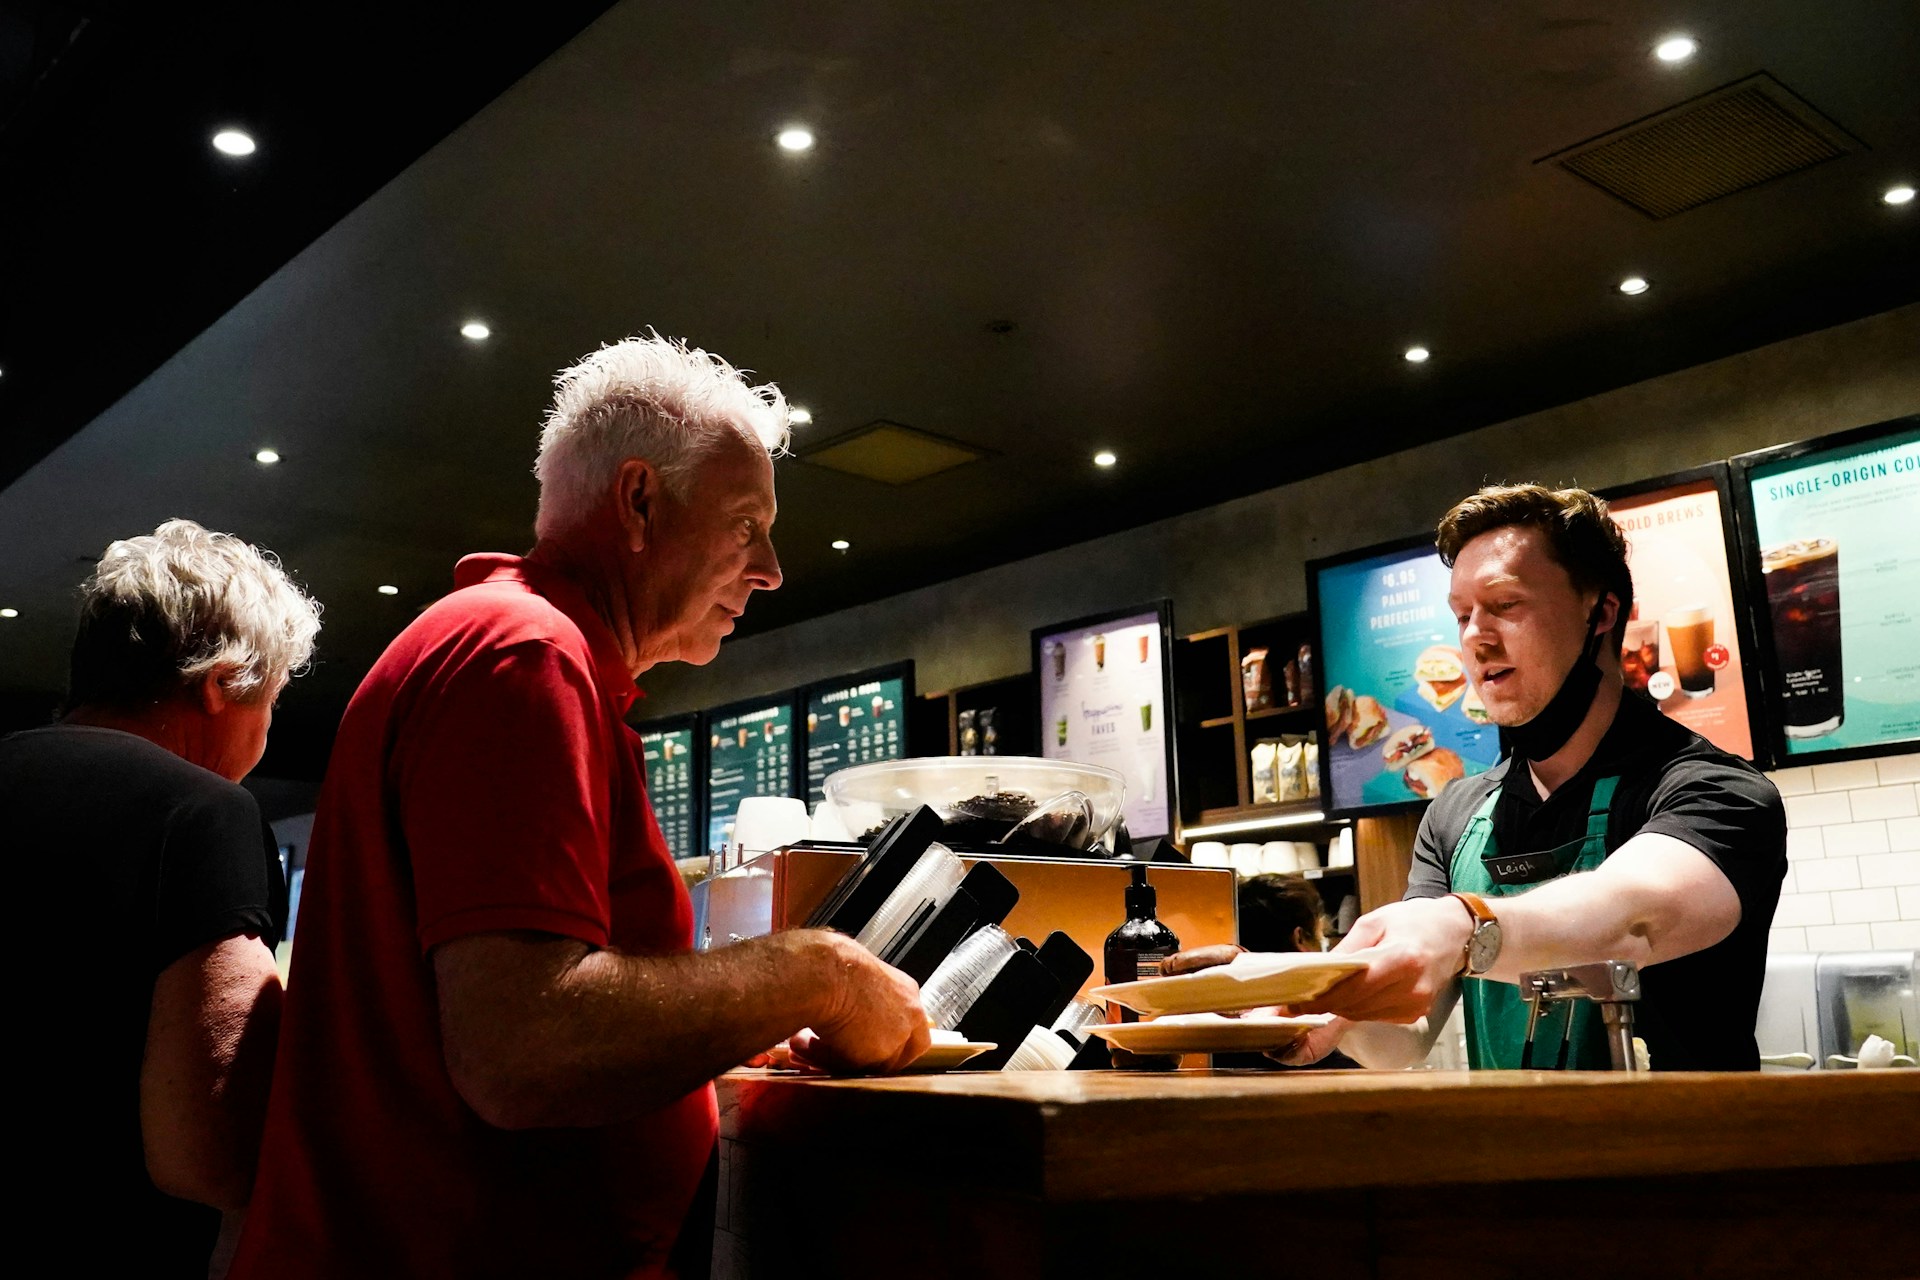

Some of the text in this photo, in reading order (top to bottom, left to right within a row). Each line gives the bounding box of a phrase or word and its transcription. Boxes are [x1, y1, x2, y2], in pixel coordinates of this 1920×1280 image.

[1770, 462, 1887, 501] SINGLE-ORIGIN
[1657, 504, 1704, 526] BREWS
[1381, 588, 1420, 609] PANINI
[1370, 605, 1435, 630] PERFECTION
[1496, 860, 1536, 877] Leigh
